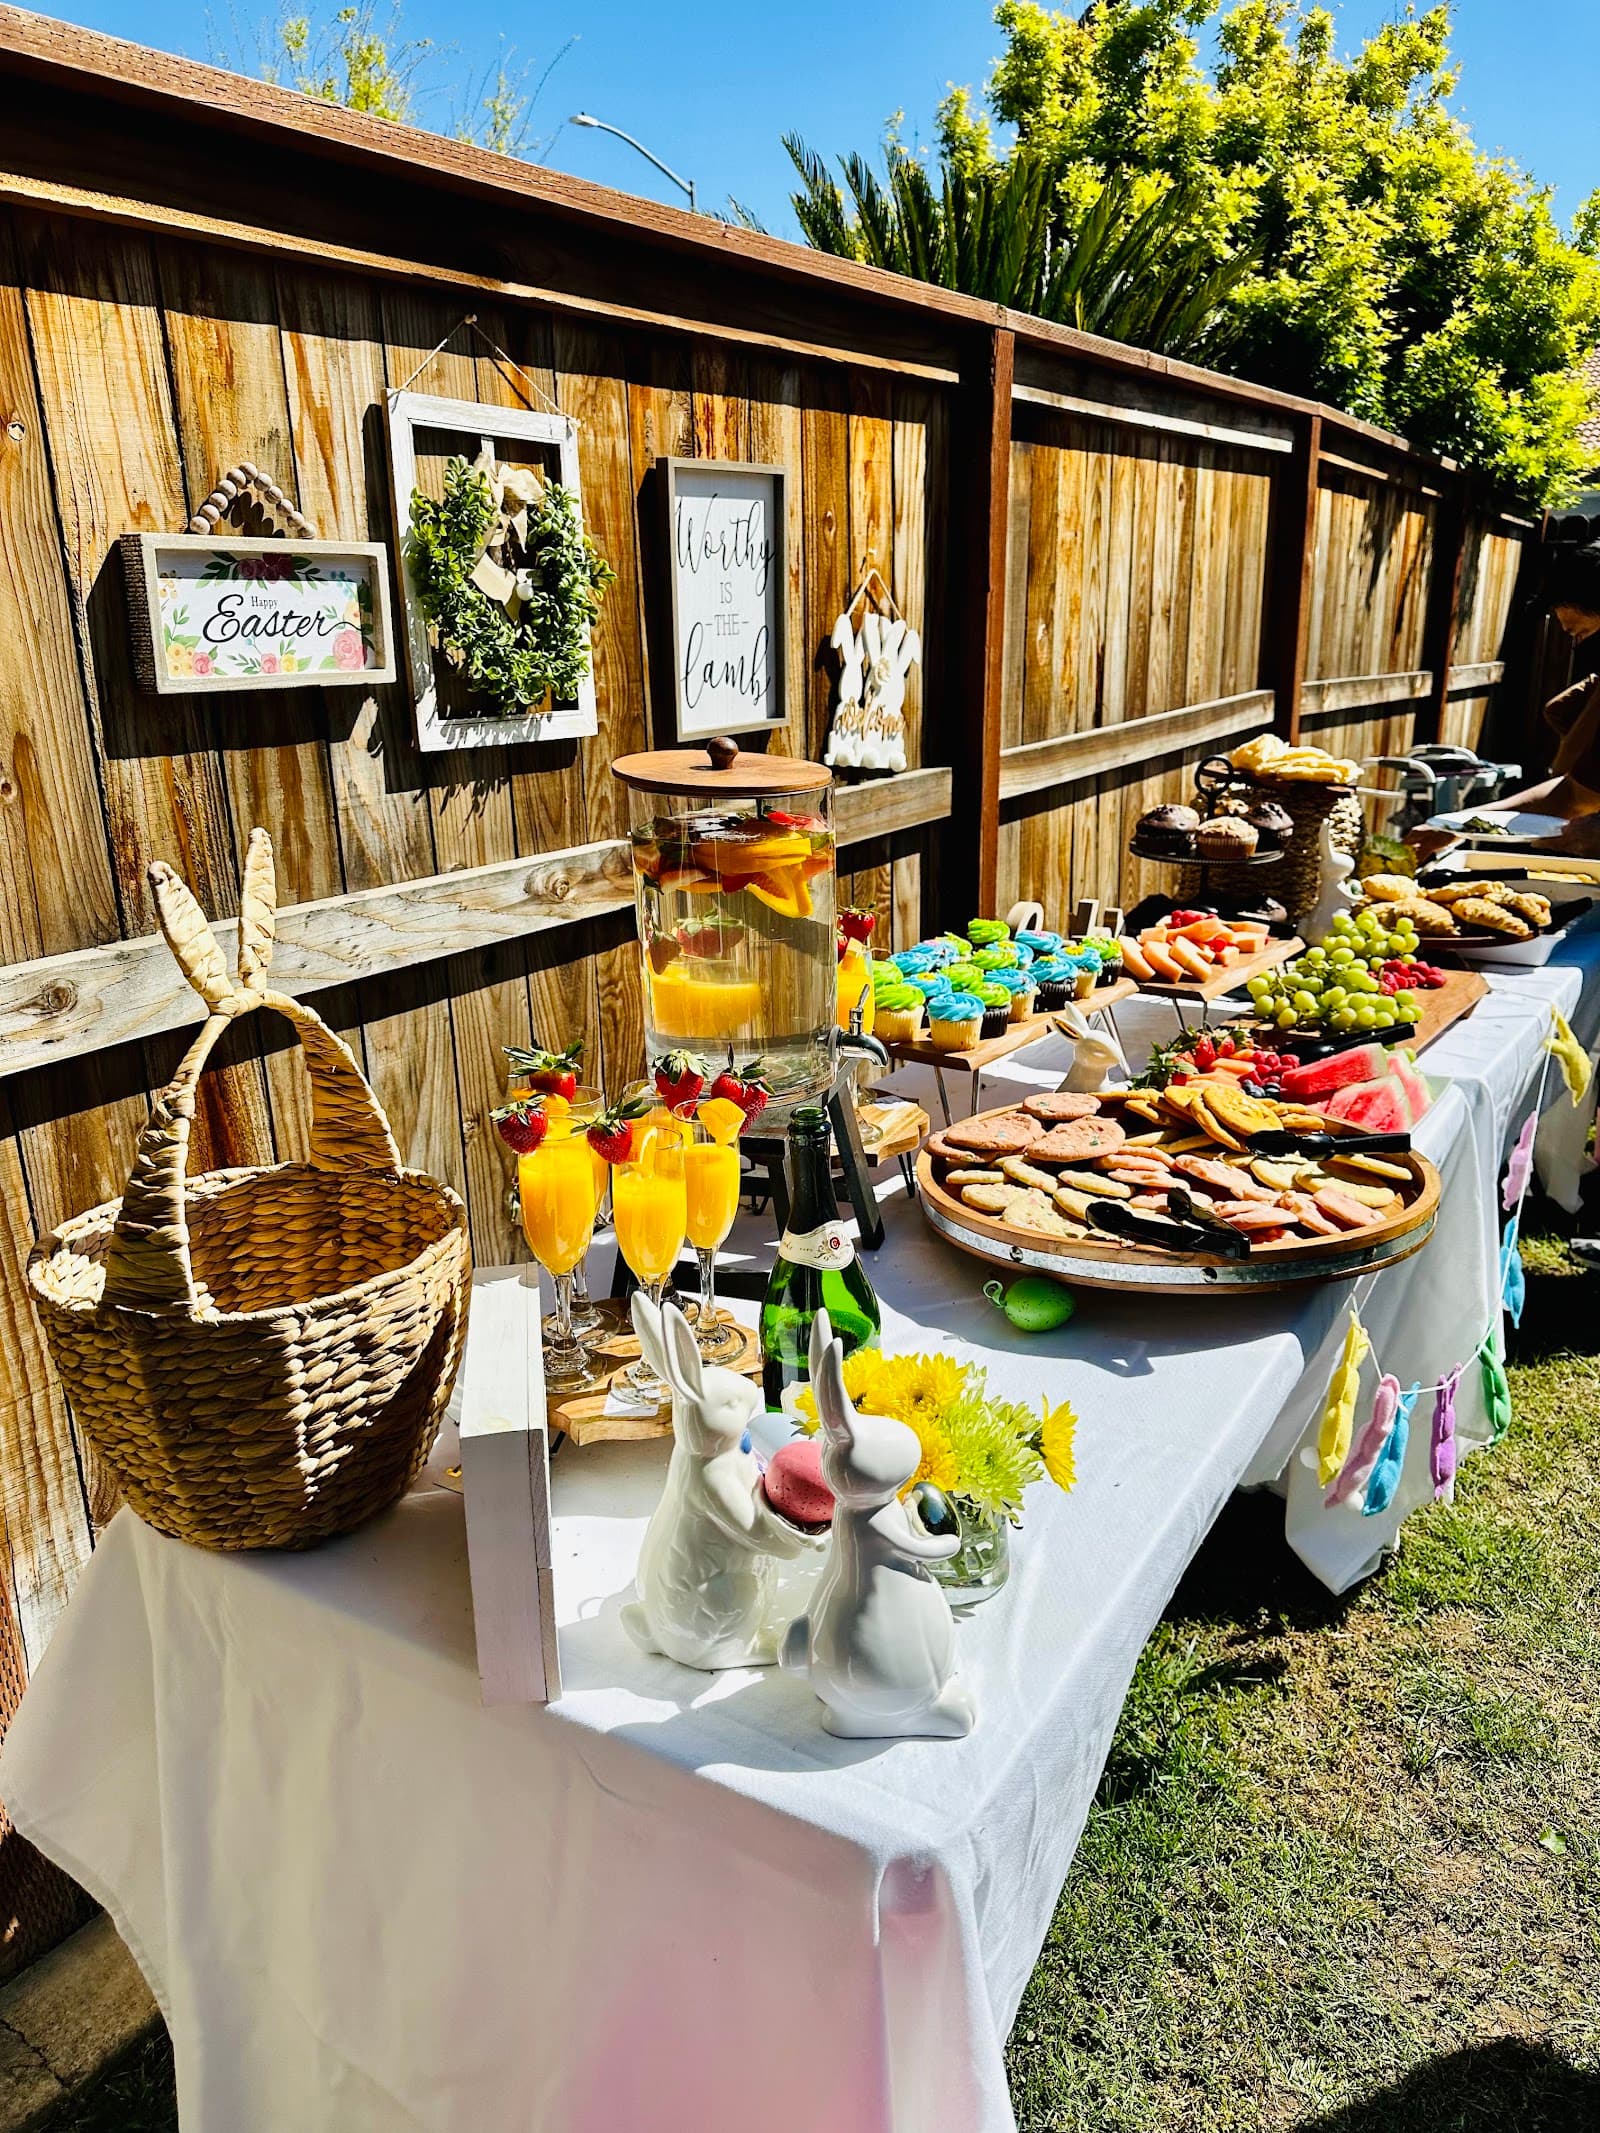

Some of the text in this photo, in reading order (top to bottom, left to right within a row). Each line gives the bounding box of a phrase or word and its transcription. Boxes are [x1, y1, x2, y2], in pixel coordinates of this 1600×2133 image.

[675, 492, 776, 597] Worthy
[251, 595, 279, 610] Happy
[719, 581, 733, 605] IS
[202, 593, 362, 643] Easter
